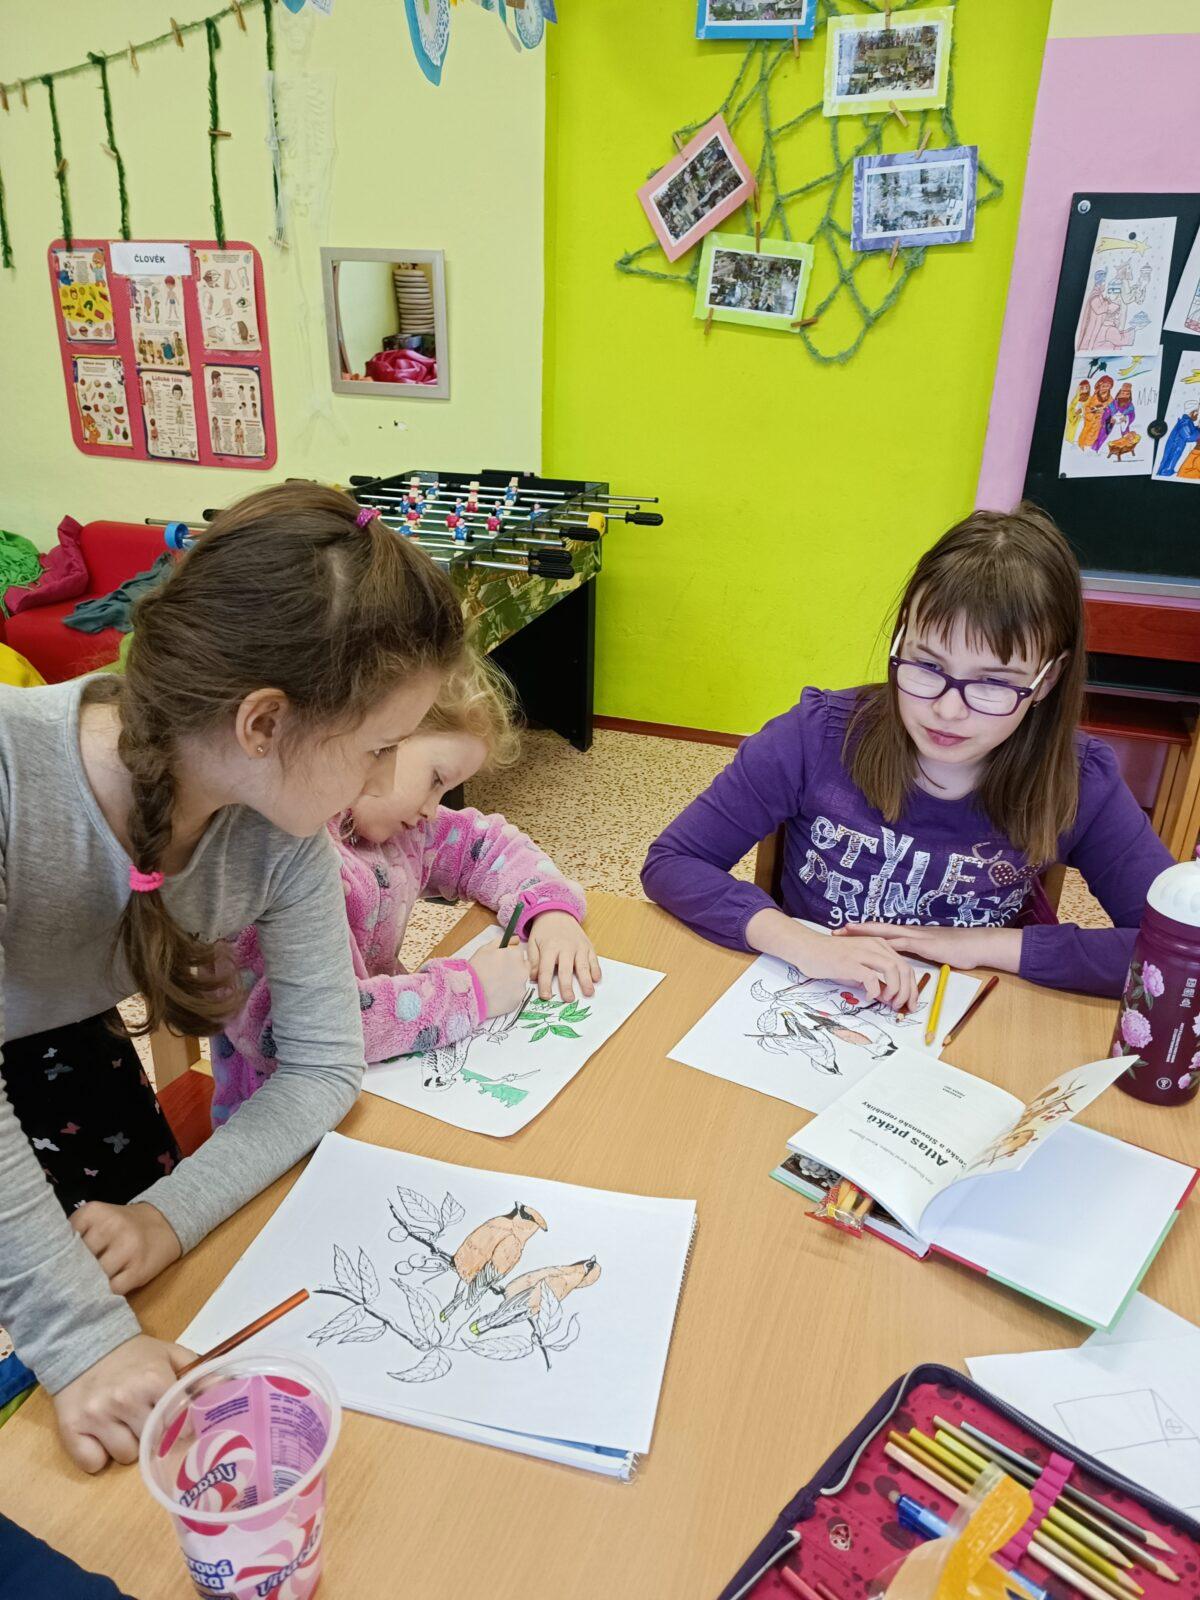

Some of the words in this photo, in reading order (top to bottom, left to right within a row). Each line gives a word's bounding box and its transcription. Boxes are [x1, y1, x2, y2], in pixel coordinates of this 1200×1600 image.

[134, 254, 166, 263] ČLOVĚK
[861, 1101, 898, 1121] republiky
[867, 1114, 909, 1139] ptáků
[910, 1136, 949, 1167] Atlas
[187, 1559, 233, 1577] rová
[190, 1569, 224, 1589] ata
